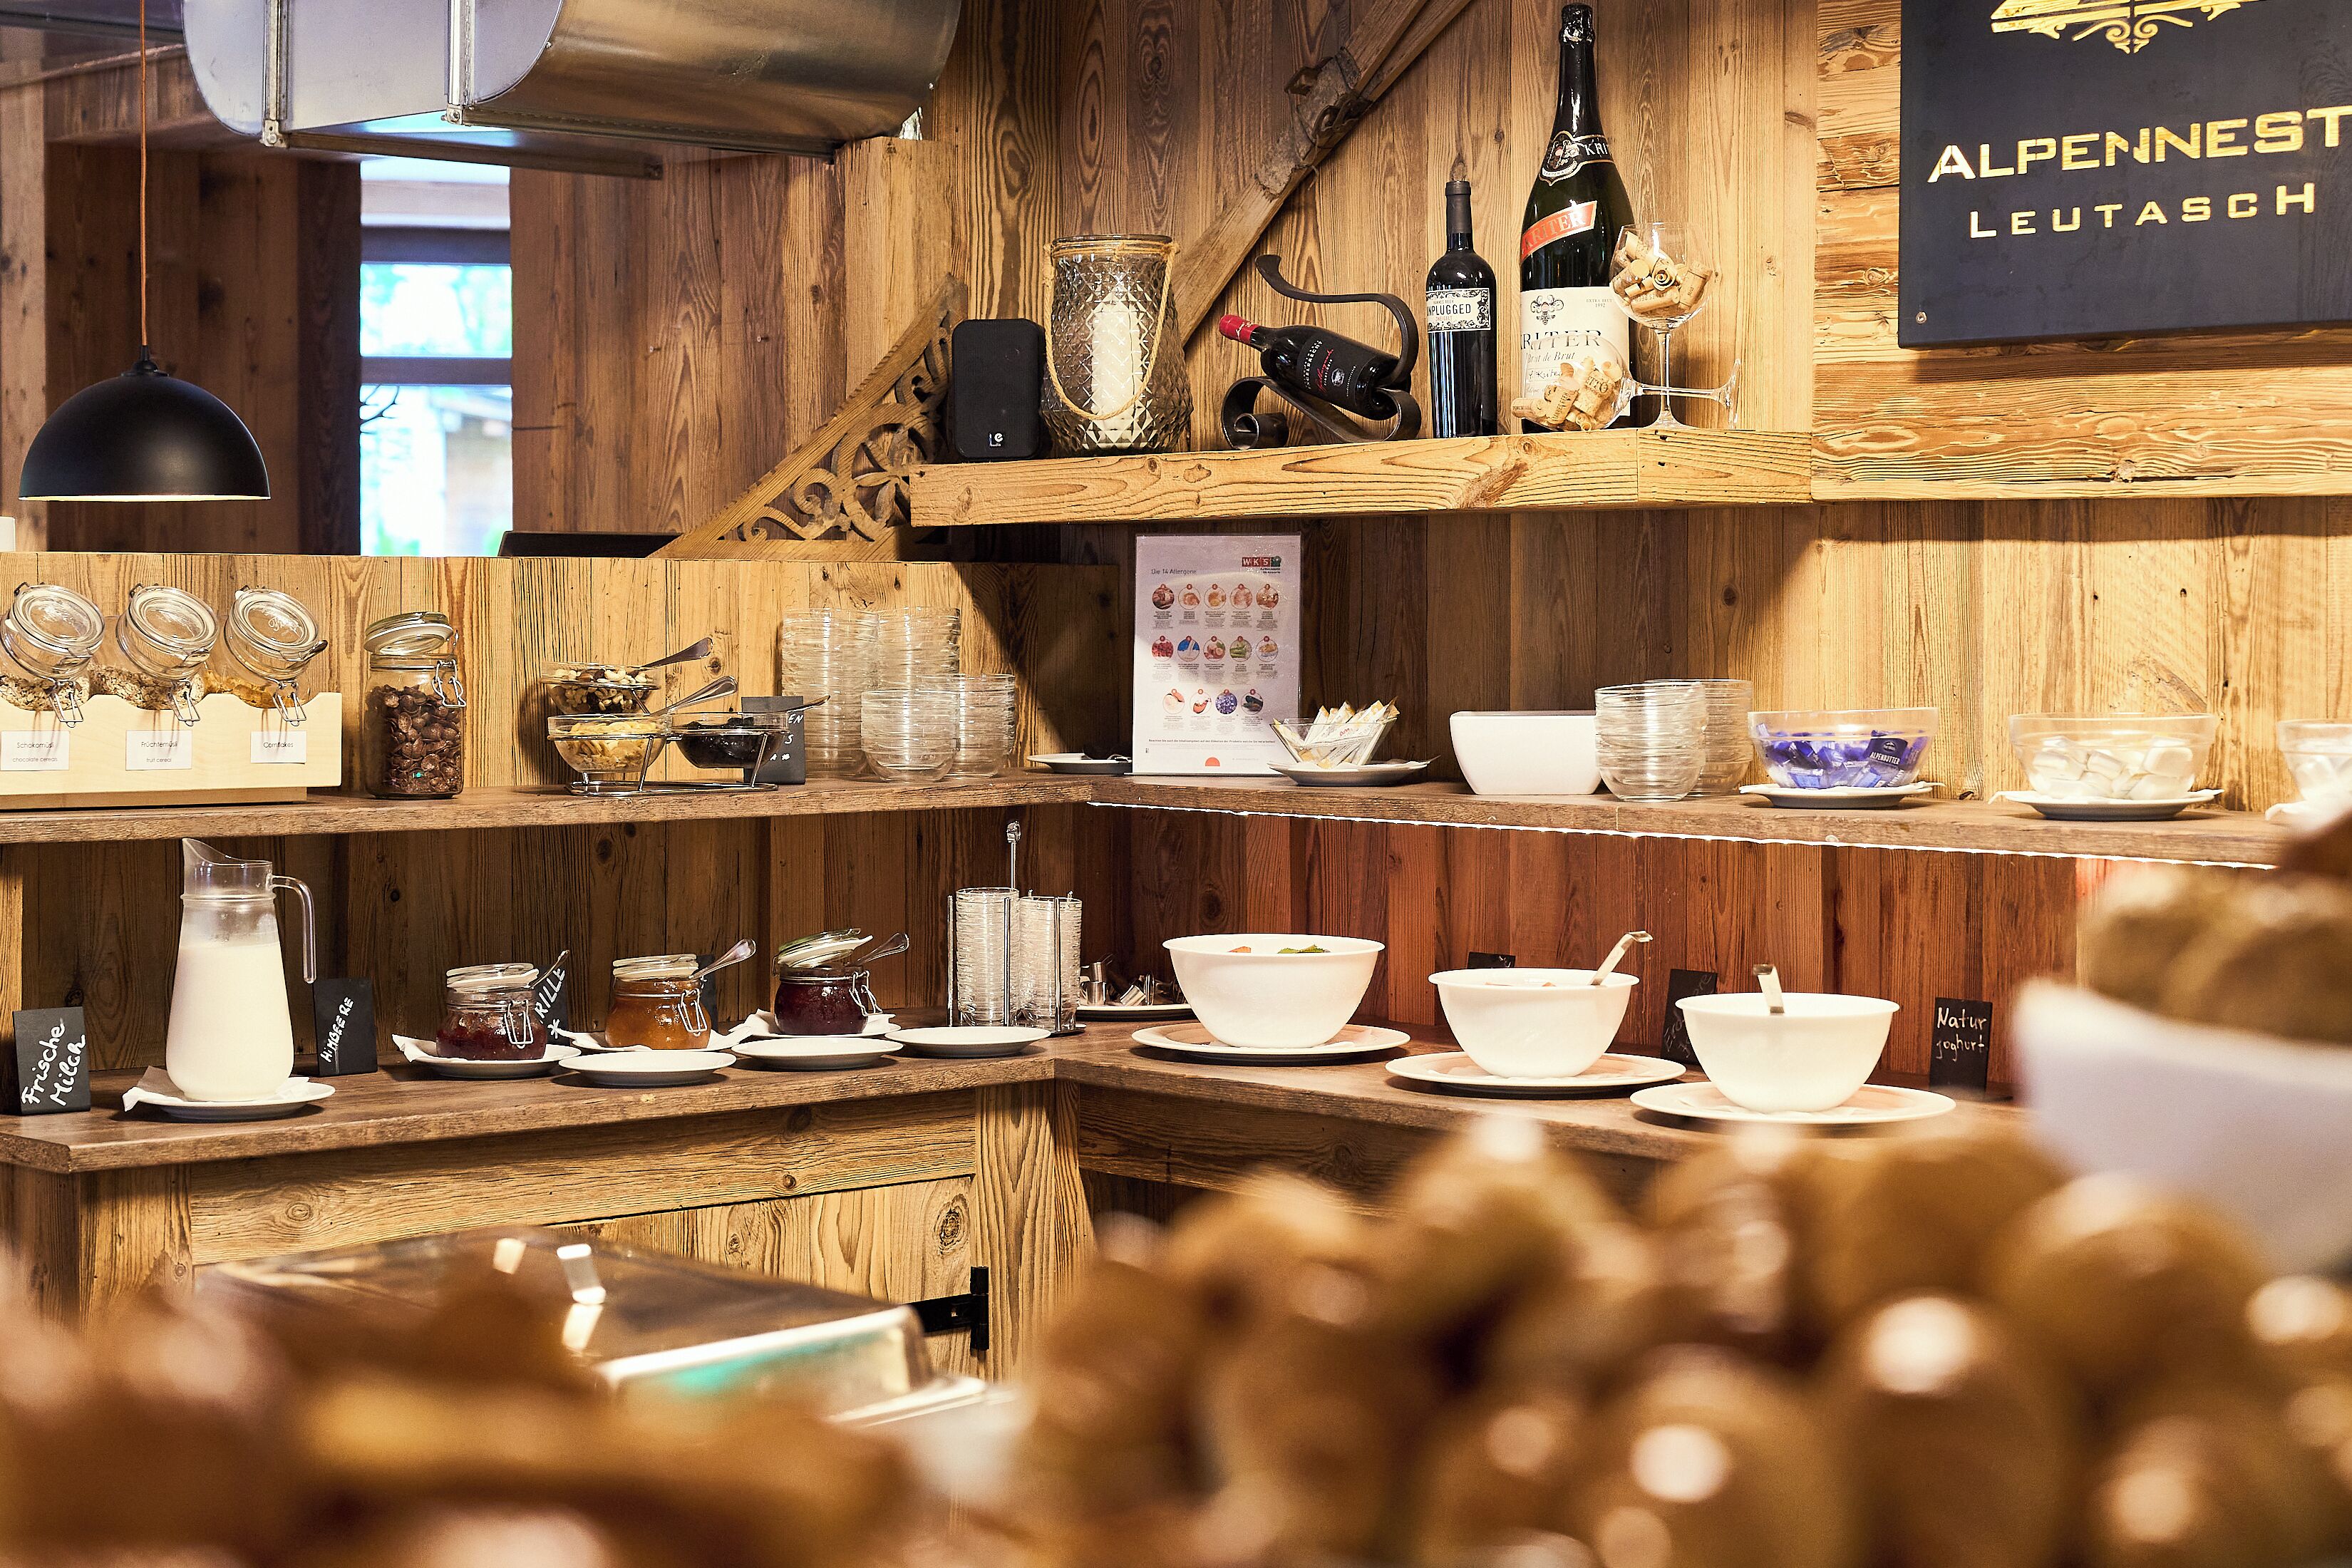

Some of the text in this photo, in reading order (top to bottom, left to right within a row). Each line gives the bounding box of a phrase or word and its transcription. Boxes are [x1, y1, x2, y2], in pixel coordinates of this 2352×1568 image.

[1927, 105, 2352, 183] ALPENNEST
[1970, 182, 2315, 238] LEUTASCH
[1427, 304, 1471, 316] NPLUGGED
[1936, 1006, 1987, 1031] Natur
[21, 1017, 66, 1104] Frische
[49, 1034, 86, 1106] Milch
